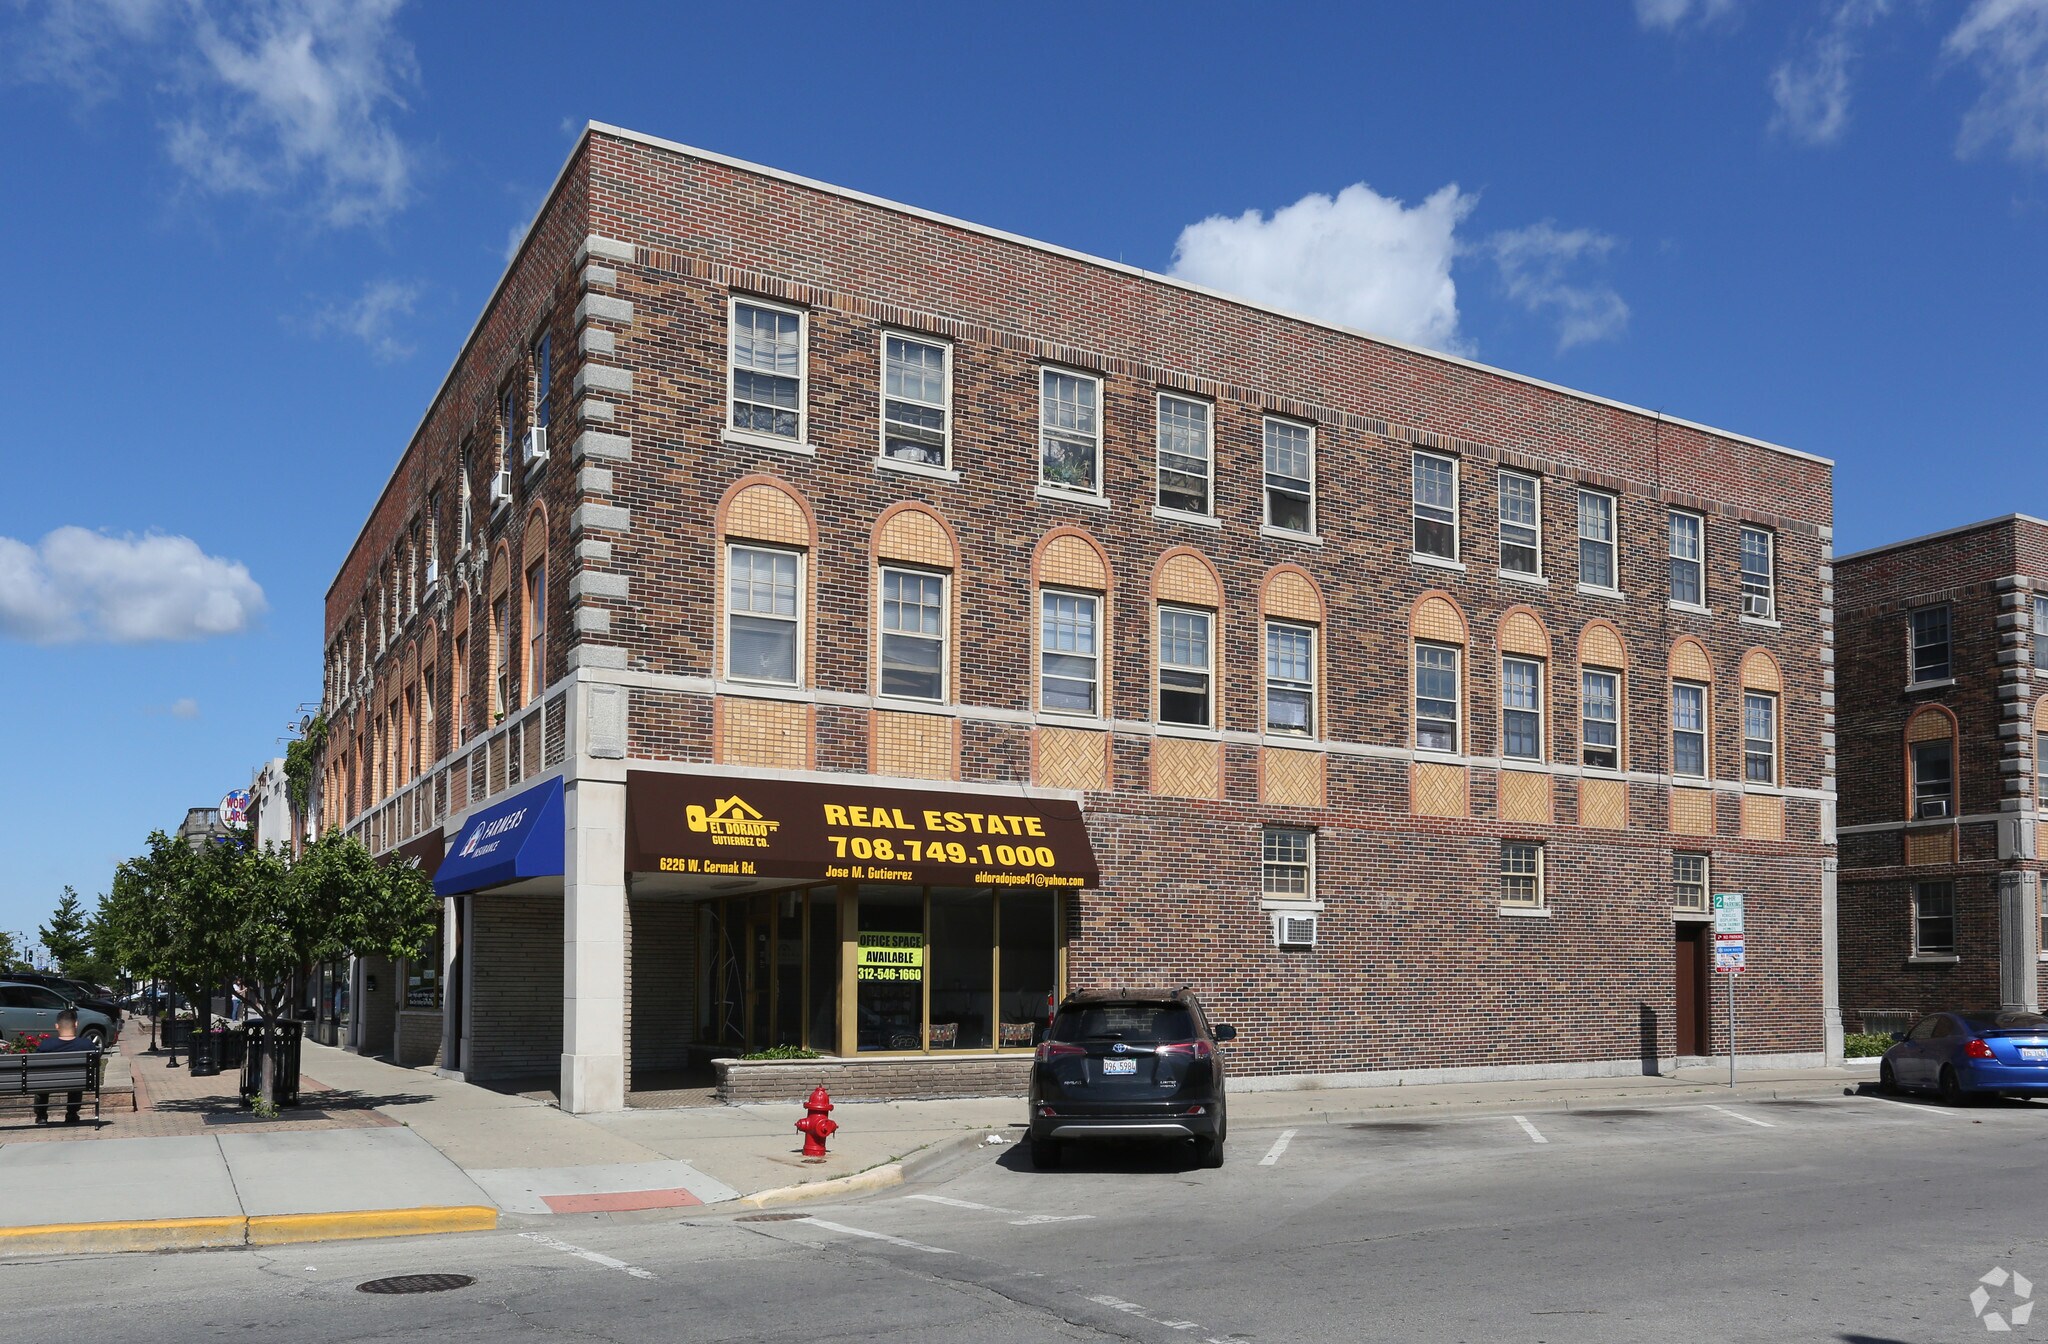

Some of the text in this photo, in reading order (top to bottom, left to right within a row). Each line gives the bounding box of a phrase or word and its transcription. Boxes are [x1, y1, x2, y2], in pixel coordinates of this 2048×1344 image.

[481, 807, 528, 840] FARMERS
[823, 803, 1046, 837] REAL ESTATE
[709, 821, 768, 837] EL DORADO
[711, 835, 770, 848] GUTIERREZ CO.
[827, 836, 1056, 868] 708.749.1000
[660, 857, 757, 875] 6226 W. Cermak Rd.
[825, 864, 913, 881] Jose M. Gutierrez
[975, 871, 1085, 887] eldoradojose41@yahoo.com
[1715, 896, 1723, 908] 2
[860, 934, 921, 948] OFFICE SPACE
[866, 950, 914, 964] AVAILABLE
[858, 967, 922, 981] 312-546-1660
[1119, 1061, 1136, 1071] 5984
